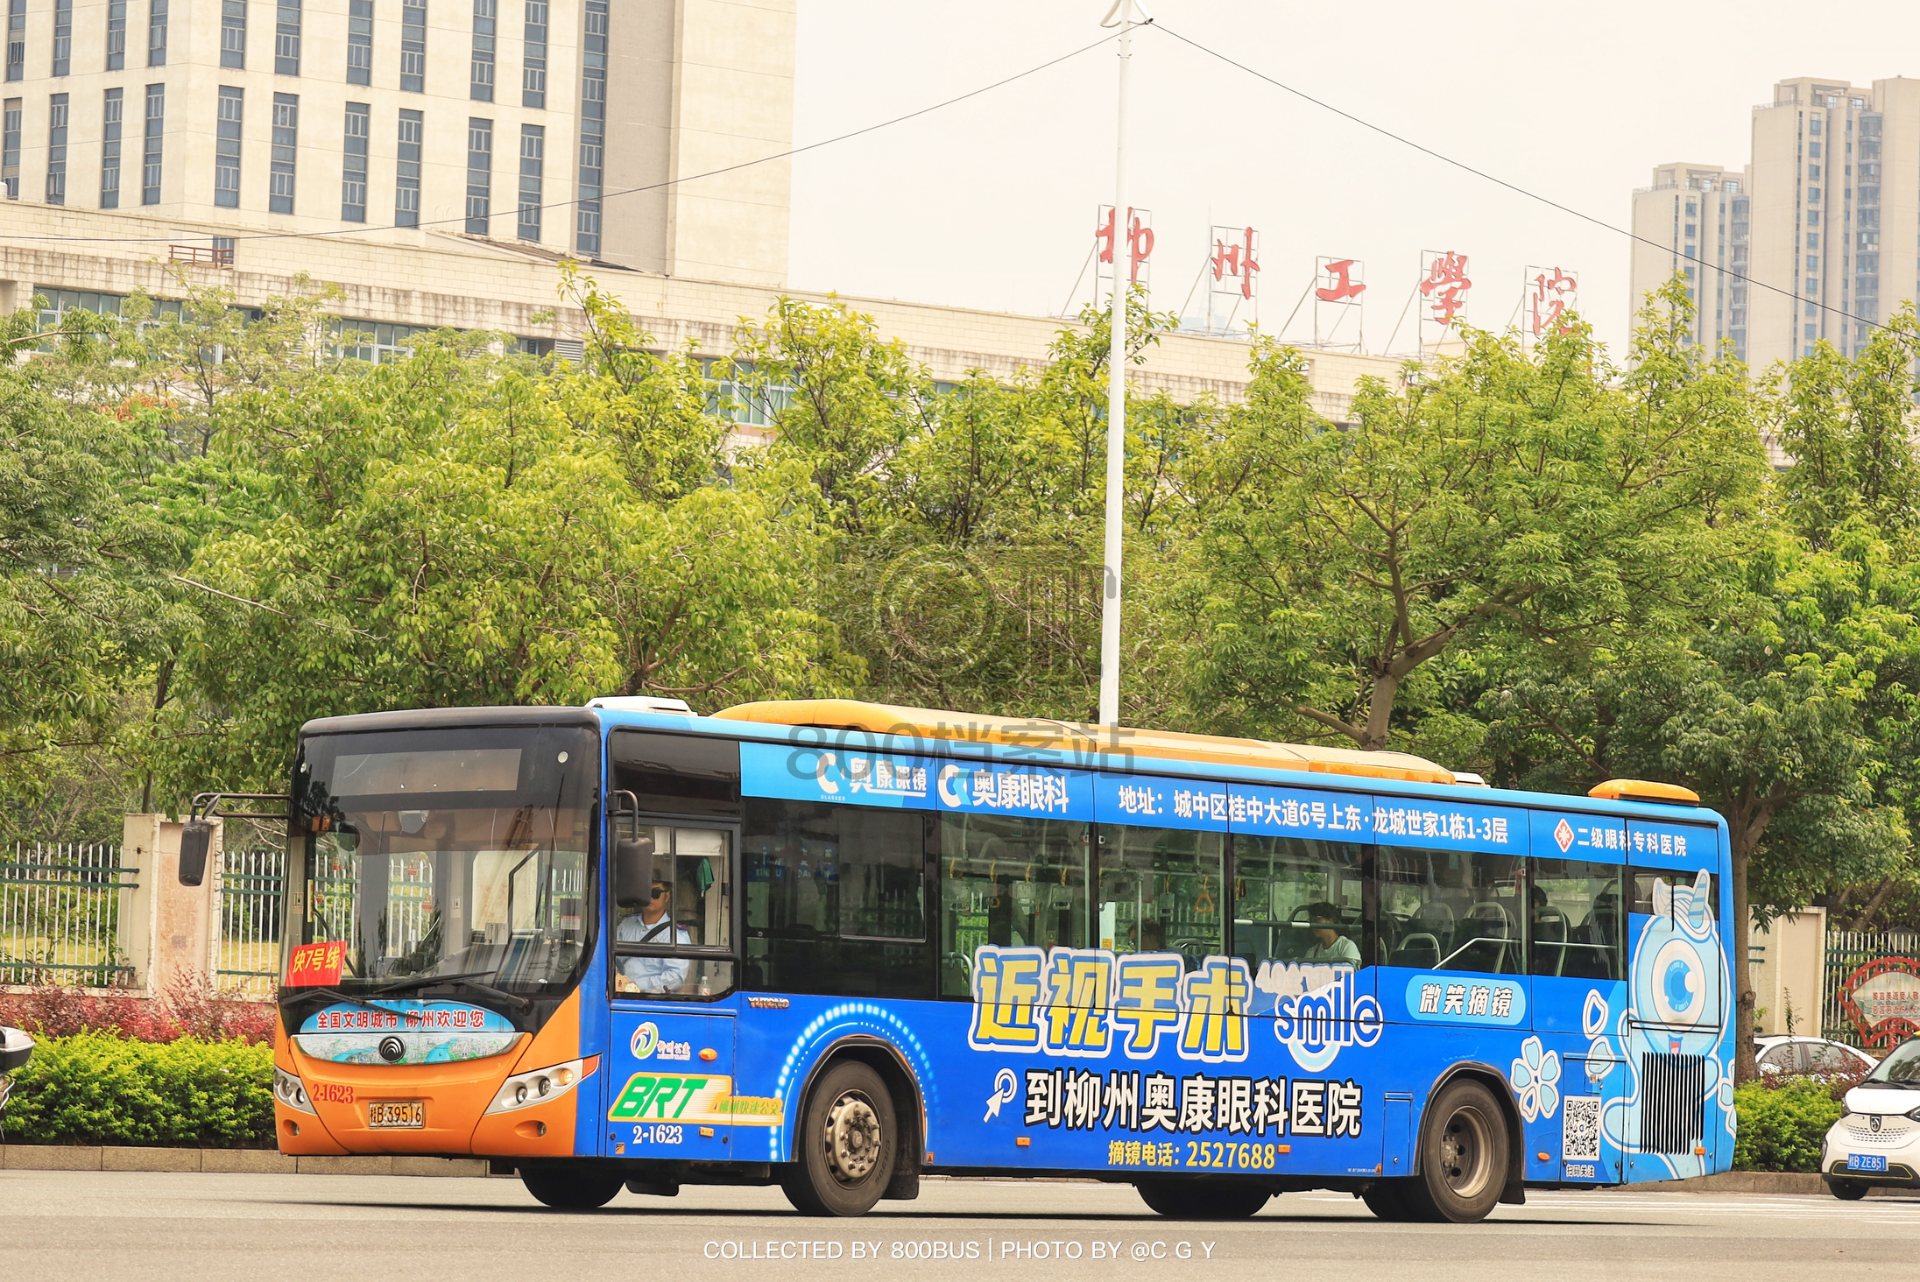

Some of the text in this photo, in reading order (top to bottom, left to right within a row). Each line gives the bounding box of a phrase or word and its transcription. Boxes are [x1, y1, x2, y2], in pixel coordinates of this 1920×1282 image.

[849, 757, 927, 793] 奥康眼镜
[973, 769, 1069, 813] 奥康眼科
[1577, 827, 1687, 857] 二级眼科专科医院
[292, 946, 340, 973] 快7号线
[970, 947, 1252, 1061] 近视手术
[1275, 968, 1383, 1047] smile
[1418, 983, 1514, 1018] 微笑摘镜
[317, 1010, 485, 1029] 全国文明城市 柳州欢迎您
[313, 1083, 354, 1104] 2-1623
[611, 1076, 709, 1119] BRT
[1025, 1070, 1362, 1137] 到柳州奥康眼科医院
[632, 1124, 683, 1145] 2-1623
[1566, 1164, 1595, 1178] 扫码关注
